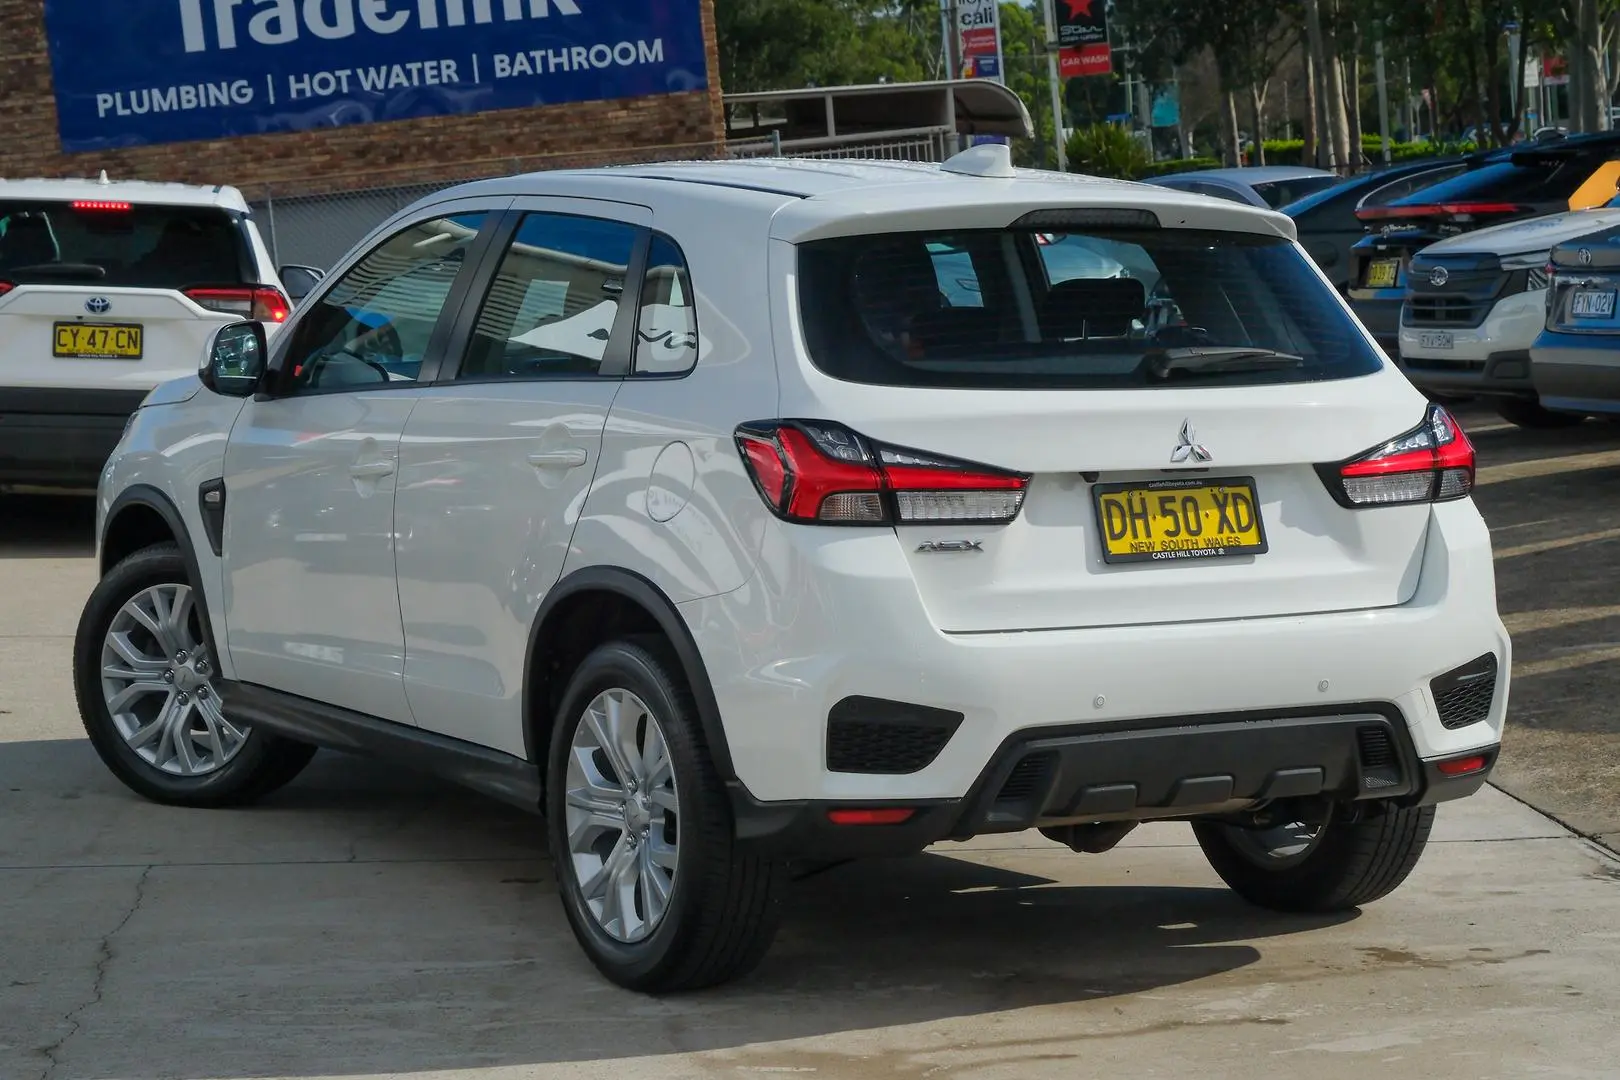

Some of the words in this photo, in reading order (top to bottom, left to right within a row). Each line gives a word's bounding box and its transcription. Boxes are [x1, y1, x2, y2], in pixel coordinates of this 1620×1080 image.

[960, 7, 993, 25] cali
[178, 0, 582, 53] Trade
[1061, 57, 1080, 67] CAR
[1081, 54, 1109, 65] WASH
[96, 79, 254, 118] PLUMBING
[288, 69, 352, 99] HOT
[356, 59, 459, 91] WATER
[493, 38, 664, 78] BATHROOM
[1129, 540, 1156, 553] NEW
[1160, 538, 1199, 551] SOUTH
[1203, 536, 1241, 548] WALES
[1152, 551, 1176, 560] CASTLE
[1176, 550, 1191, 558] HILL
[1191, 548, 1216, 557] TOYOTA
